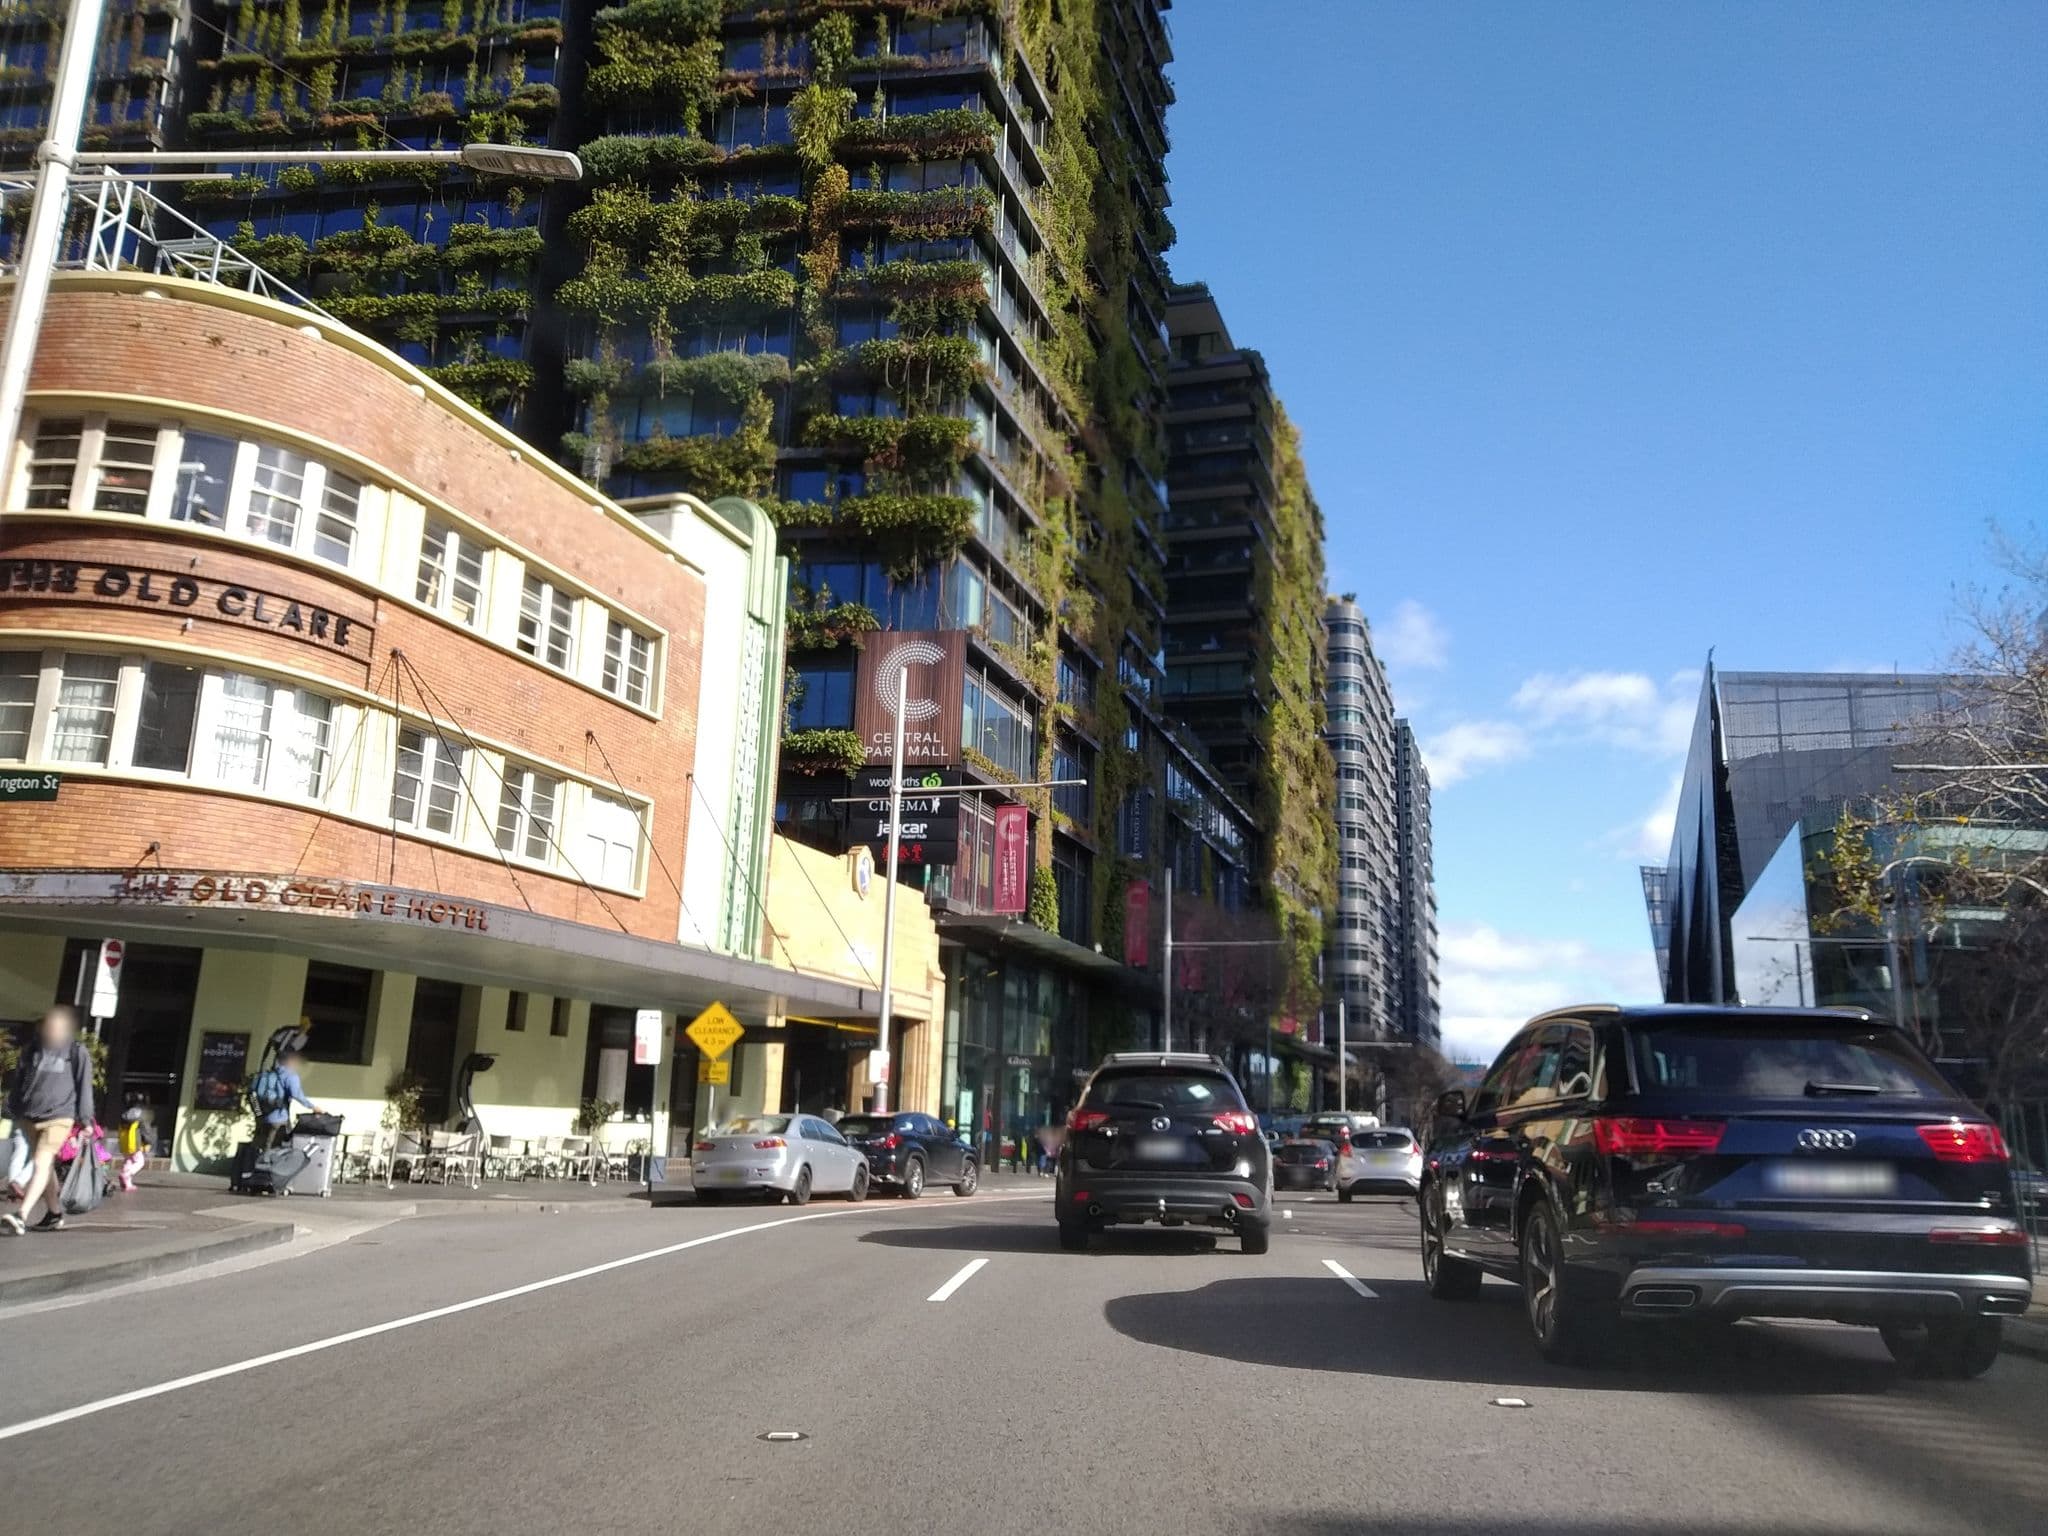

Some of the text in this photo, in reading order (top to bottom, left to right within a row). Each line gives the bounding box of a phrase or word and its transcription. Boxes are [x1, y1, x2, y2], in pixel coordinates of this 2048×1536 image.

[95, 566, 200, 607] OLD
[217, 586, 353, 647] CLARE
[873, 732, 941, 744] CETRAL
[865, 746, 949, 758] PAR MALL
[0, 774, 59, 793] ngton St
[869, 776, 920, 787] woolrths
[876, 819, 928, 837] jacar
[121, 870, 490, 932] THE OLD CLARE HOTEL
[707, 1016, 725, 1025] LOW
[694, 1026, 736, 1036] CLEARANCE
